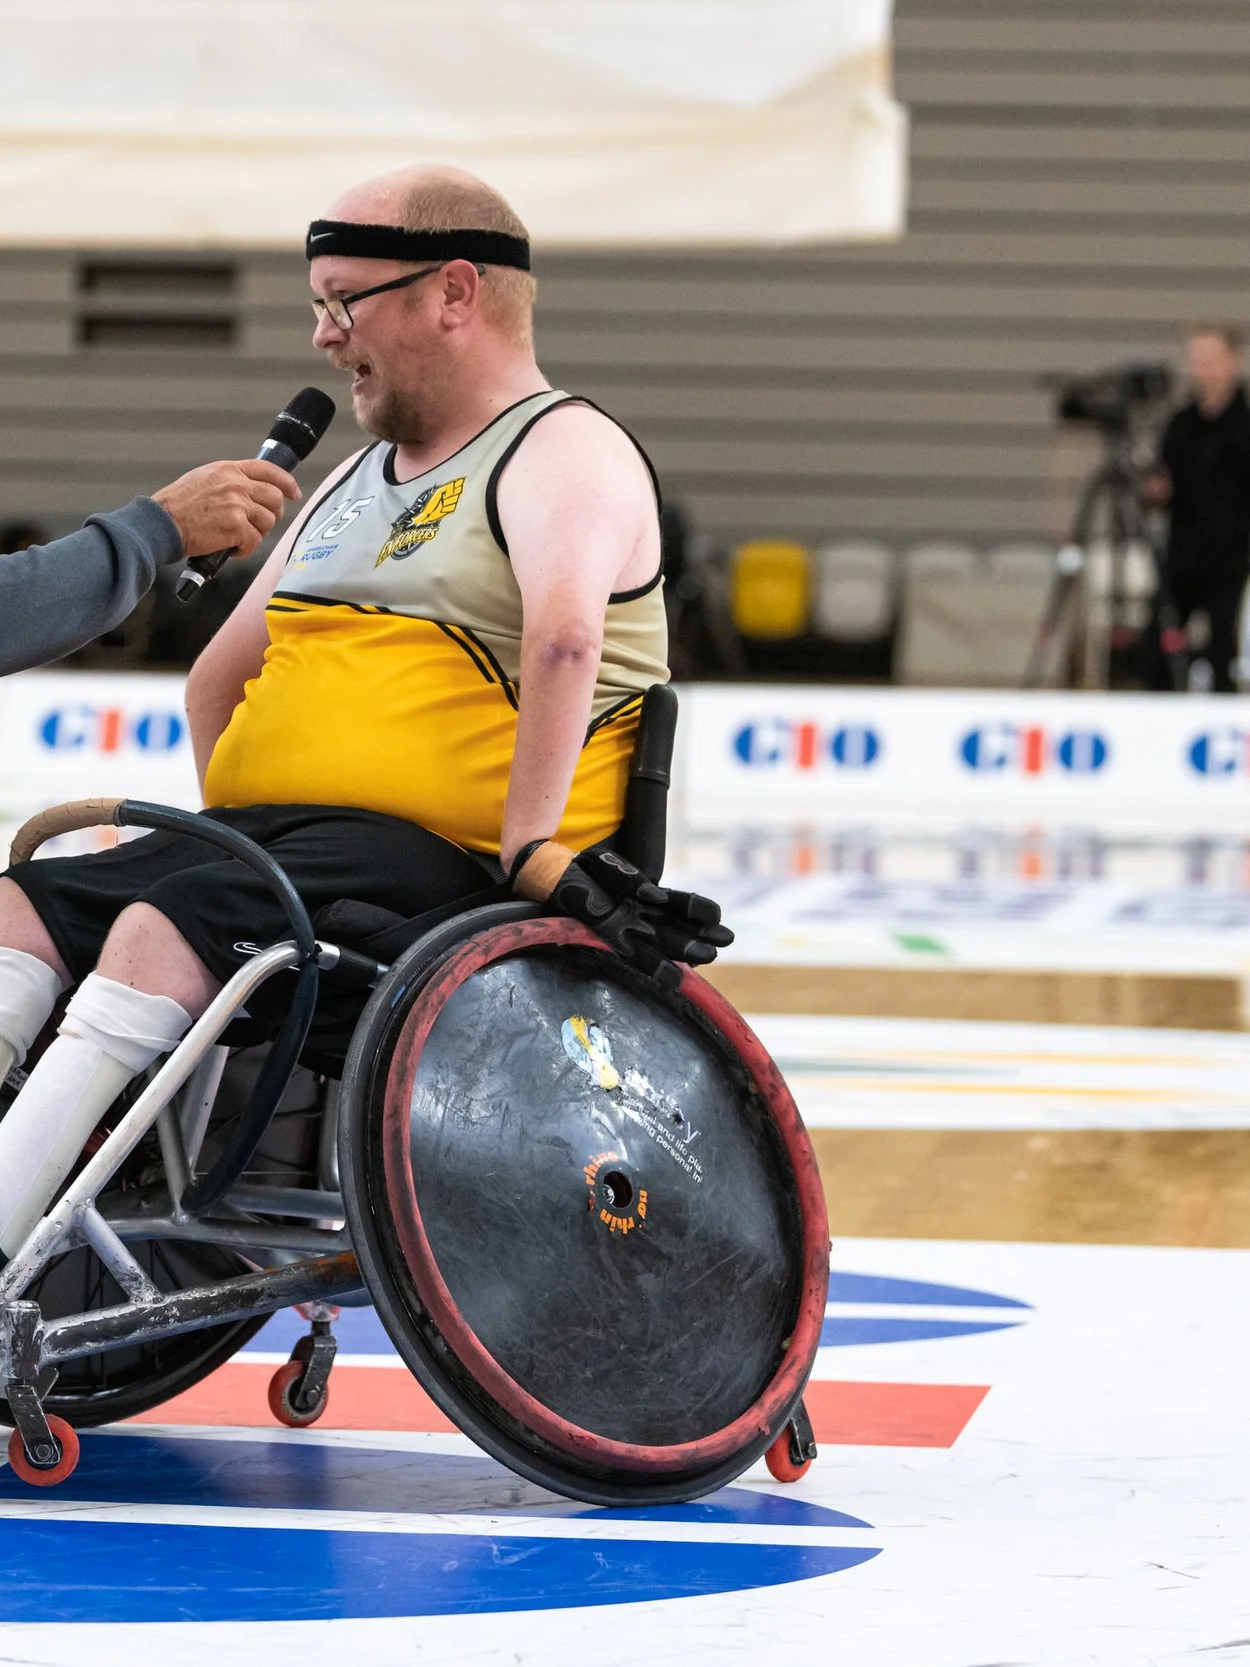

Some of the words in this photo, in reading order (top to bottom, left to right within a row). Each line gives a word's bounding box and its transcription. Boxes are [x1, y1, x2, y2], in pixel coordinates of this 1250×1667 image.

[306, 495, 375, 543] 15
[301, 549, 334, 561] RUGBY
[377, 528, 439, 564] ENFORCERS
[39, 706, 183, 752] GIO
[733, 721, 881, 769] GIO
[959, 726, 1108, 774] GIO
[657, 1123, 675, 1141] and
[656, 1135, 692, 1172] personal
